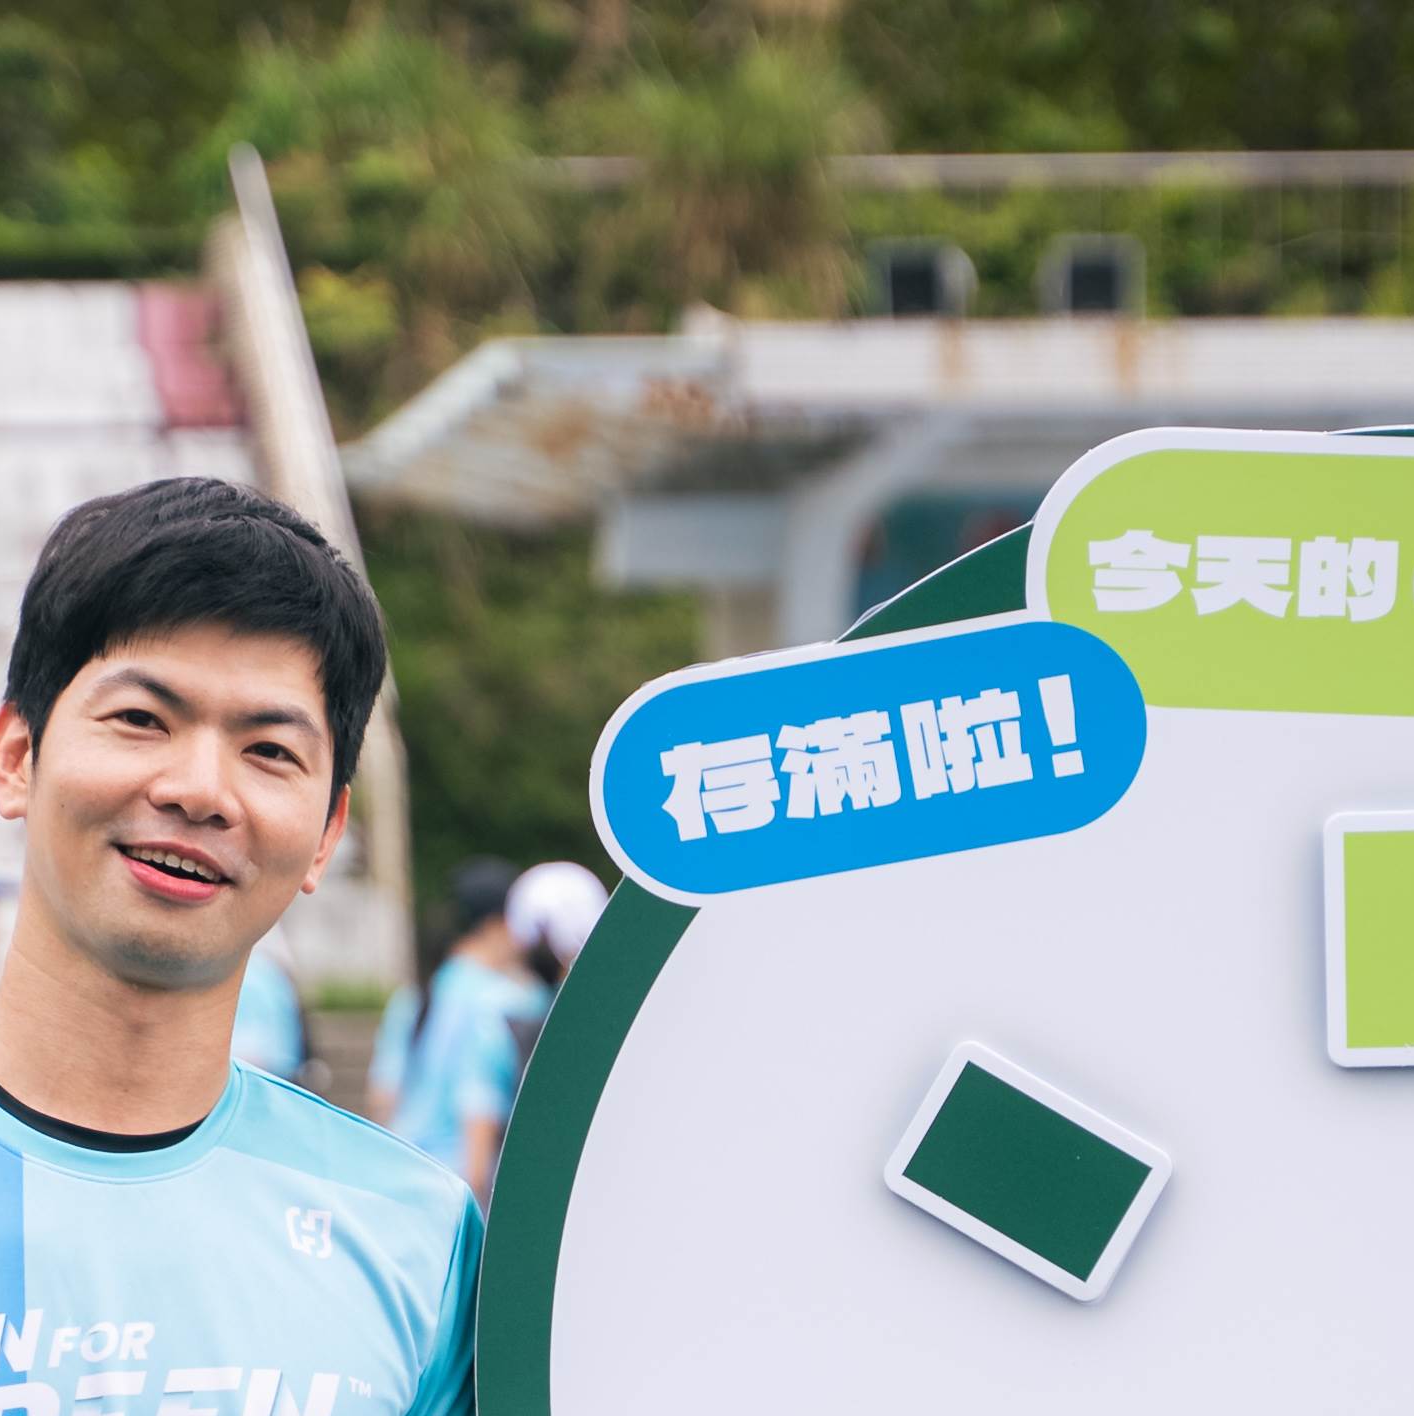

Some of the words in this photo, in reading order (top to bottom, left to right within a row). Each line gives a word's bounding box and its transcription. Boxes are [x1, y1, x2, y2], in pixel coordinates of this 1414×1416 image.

[1088, 529, 1400, 622] 今天的
[48, 1320, 156, 1368] FOR
